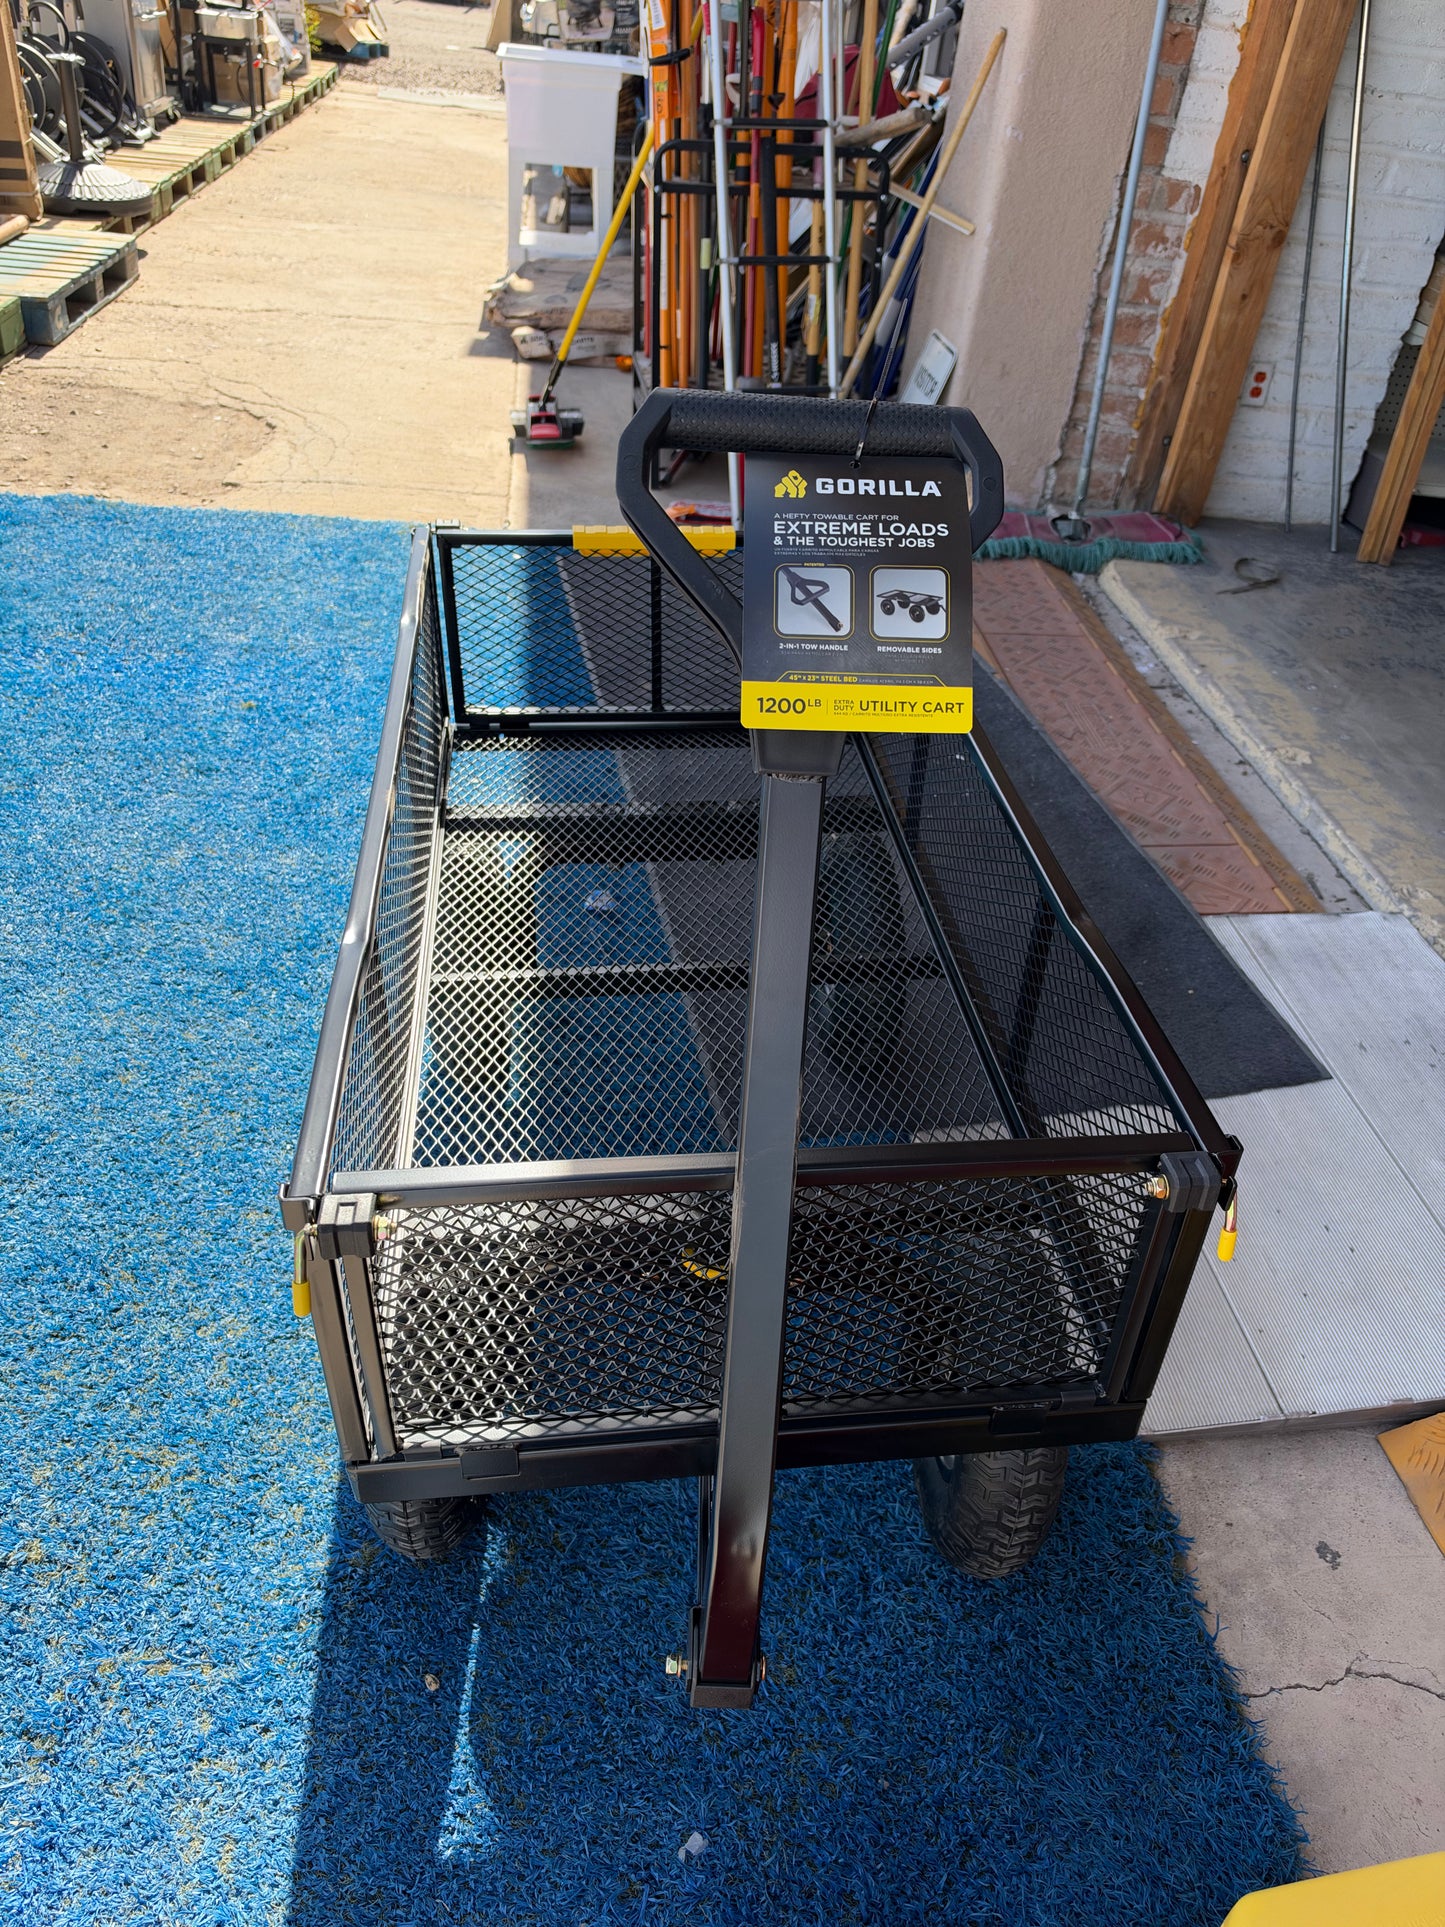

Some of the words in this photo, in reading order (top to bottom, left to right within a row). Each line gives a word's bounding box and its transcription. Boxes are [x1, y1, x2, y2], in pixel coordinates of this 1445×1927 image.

[816, 478, 941, 497] GORILLA
[774, 521, 872, 535] EXTREME
[879, 523, 949, 537] LOADS
[773, 536, 783, 546] &
[787, 536, 814, 546] THE
[819, 537, 894, 547] TOUGHEST
[898, 538, 935, 548] JOBS
[756, 697, 806, 714] 1200
[808, 698, 822, 707] LB
[860, 700, 918, 713] UTILITY
[922, 701, 965, 714] CART
